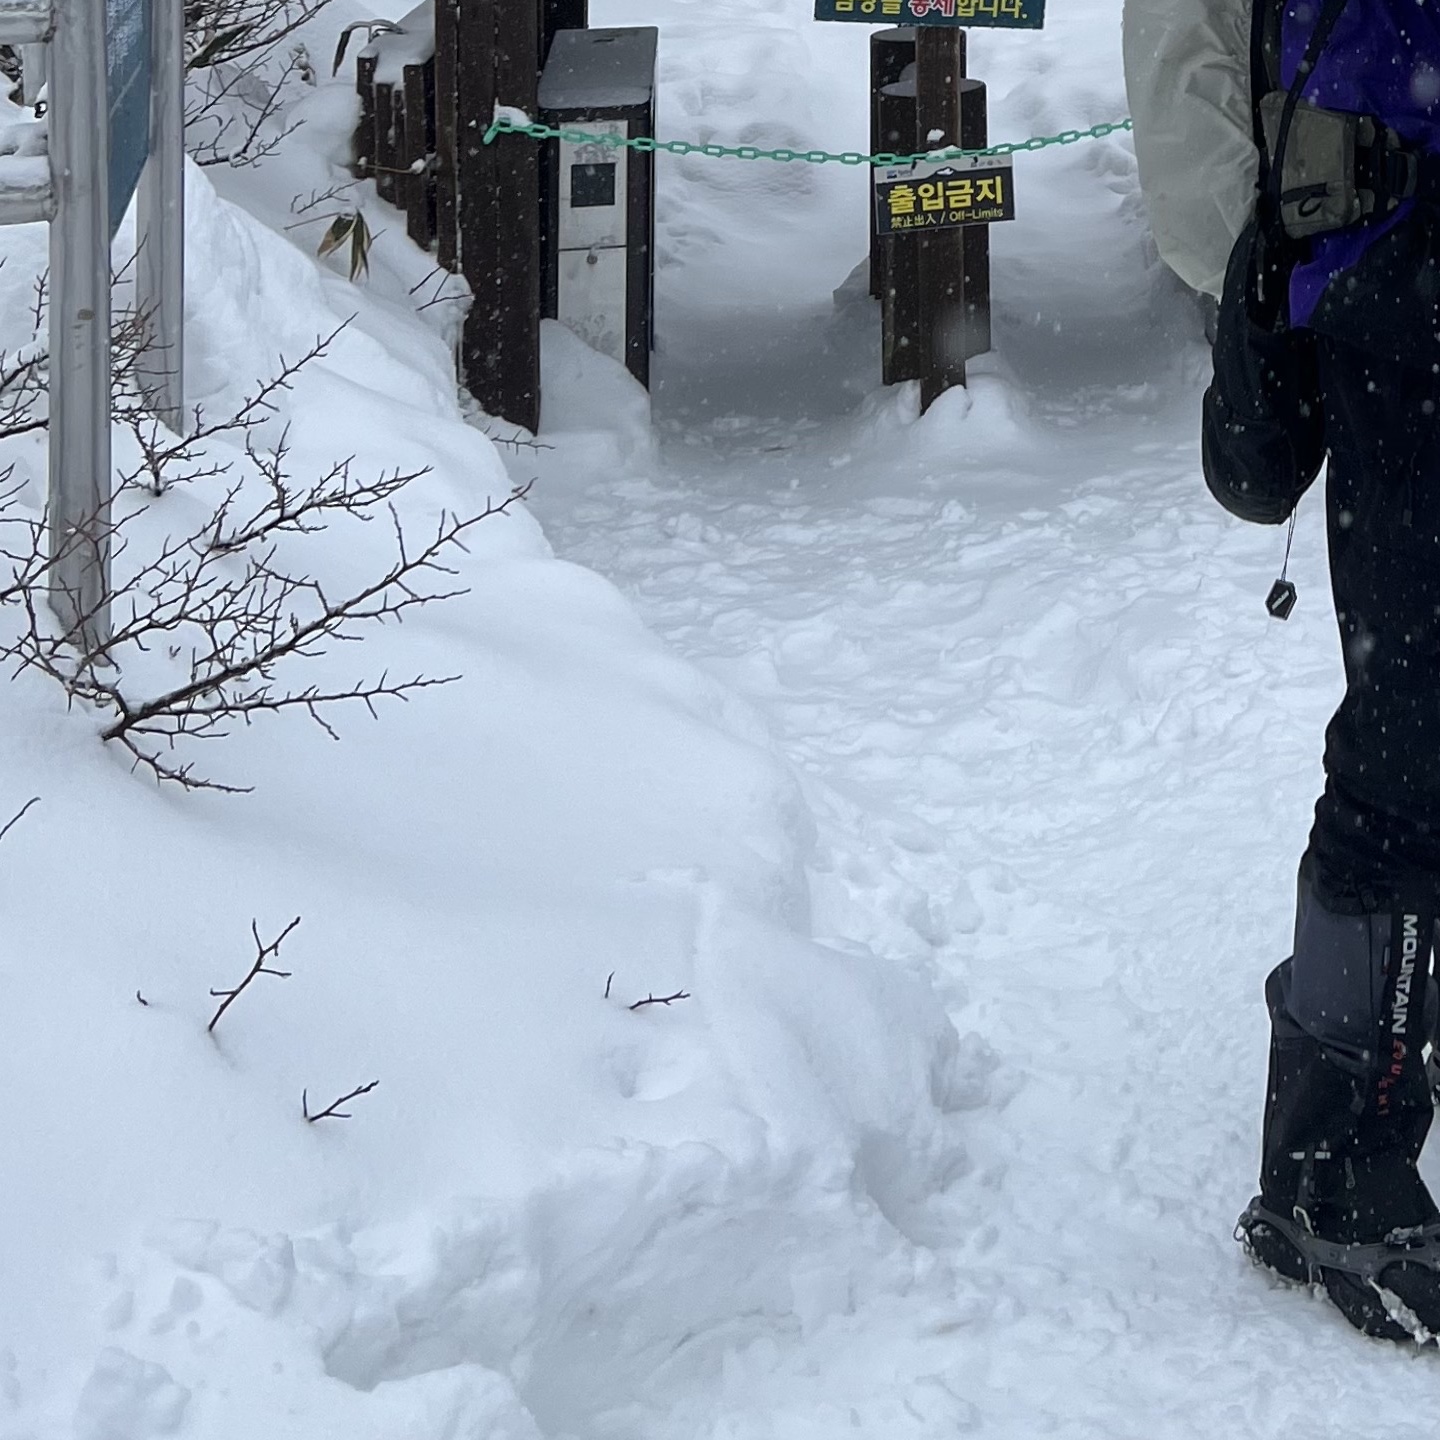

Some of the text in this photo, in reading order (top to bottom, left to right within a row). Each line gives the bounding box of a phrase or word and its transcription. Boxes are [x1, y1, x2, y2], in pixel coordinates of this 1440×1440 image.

[887, 175, 1003, 215] 출입금지
[949, 208, 1004, 222] Off-Limits
[1391, 913, 1418, 1034] MOUNTAIN
